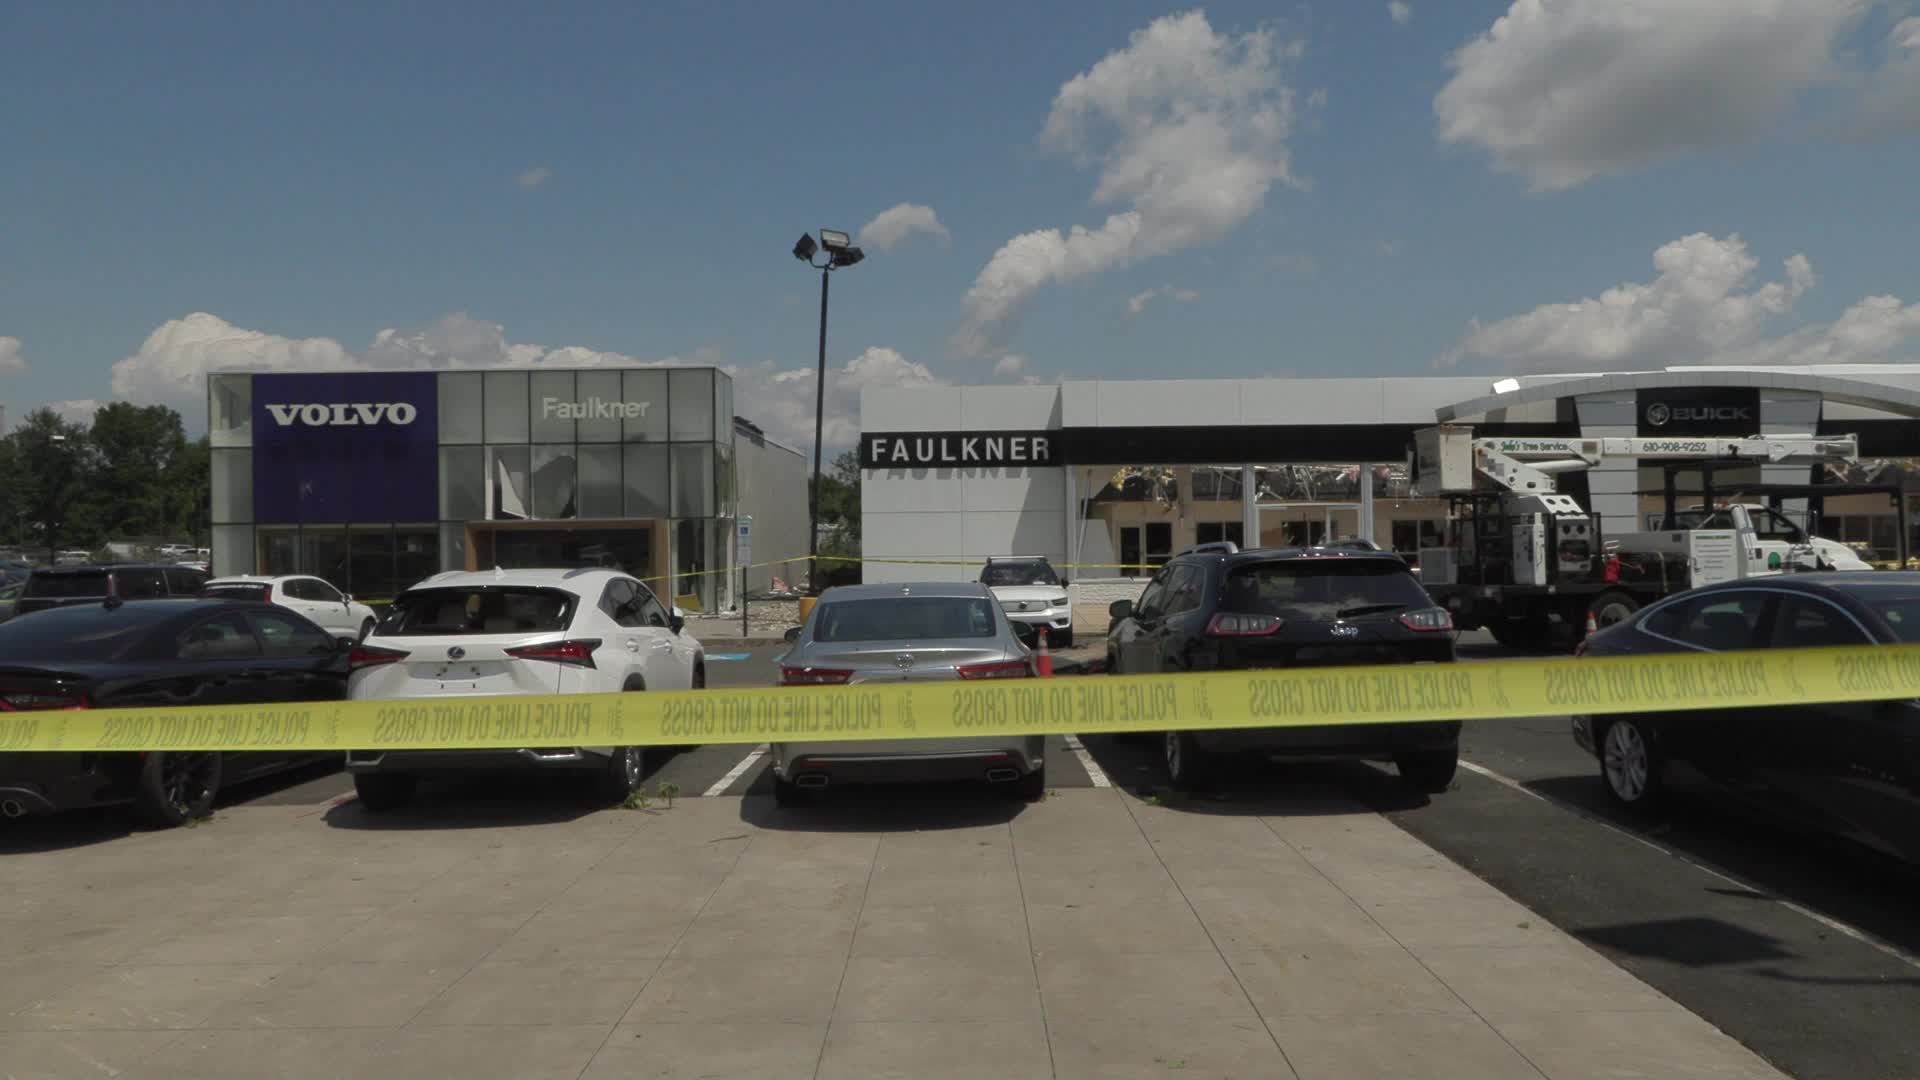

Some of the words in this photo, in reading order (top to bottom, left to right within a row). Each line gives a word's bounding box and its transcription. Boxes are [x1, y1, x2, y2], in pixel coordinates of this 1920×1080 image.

[265, 402, 417, 426] VOLVO
[543, 397, 651, 418] Faulkner
[1671, 407, 1753, 420] BUICK
[871, 437, 1049, 462] FAULKNER
[1522, 441, 1538, 451] Tree
[1540, 442, 1569, 451] Service
[1642, 441, 1707, 452] 610-908-9252
